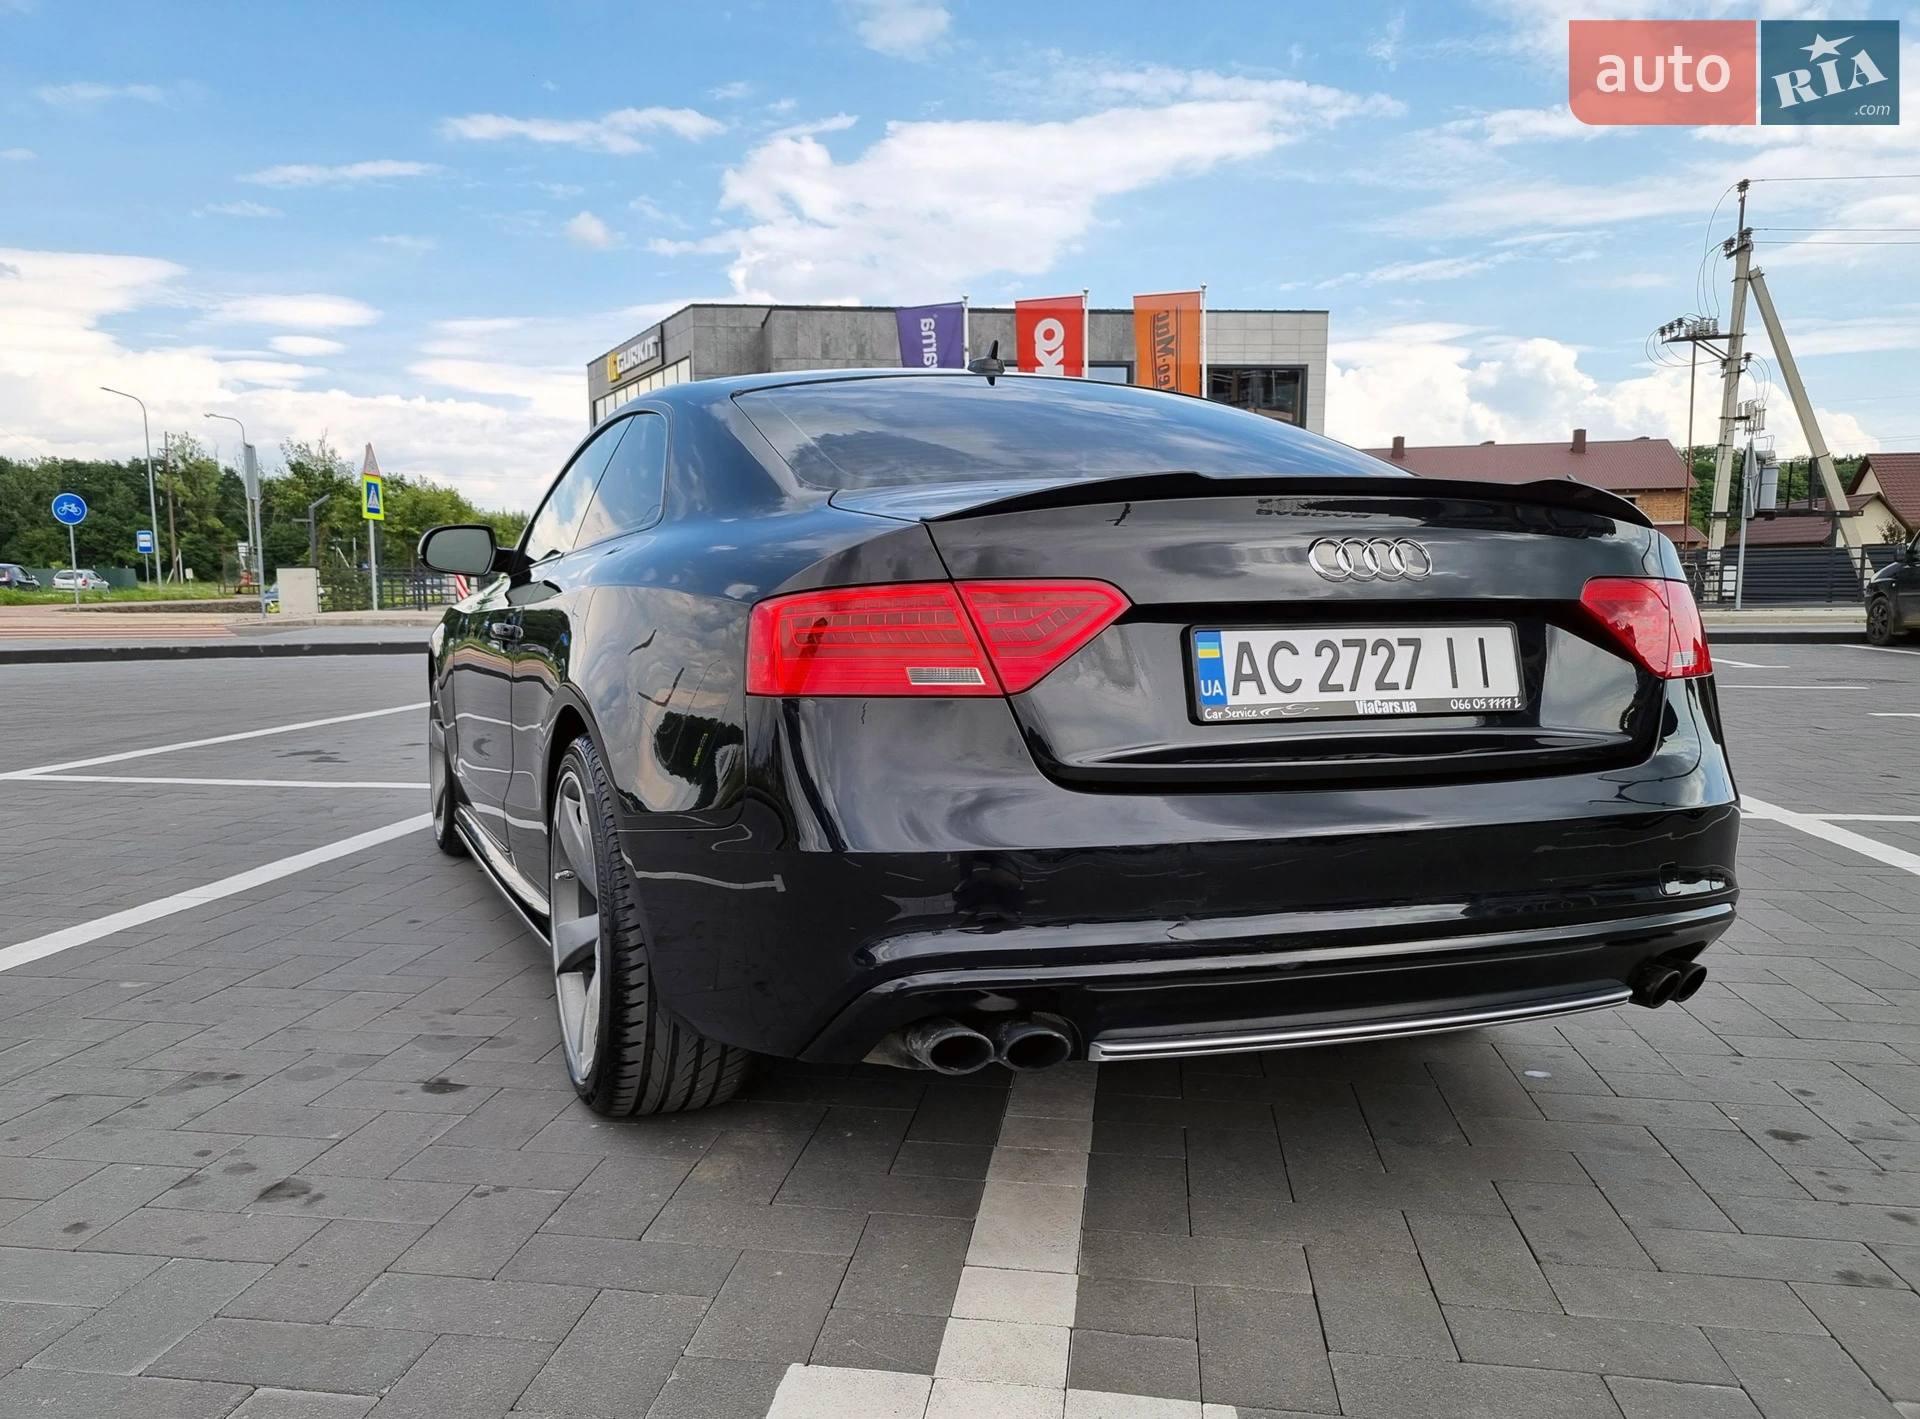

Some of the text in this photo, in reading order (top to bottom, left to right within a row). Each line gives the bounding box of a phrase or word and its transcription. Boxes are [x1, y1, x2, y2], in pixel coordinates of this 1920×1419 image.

[1232, 640, 1302, 695] AC
[1315, 638, 1421, 692] 2727
[1201, 680, 1224, 697] UA
[1355, 700, 1417, 714] ViaCars.ua
[1450, 698, 1471, 710] 066
[1472, 698, 1486, 709] 05
[1204, 706, 1257, 719] Car Service
